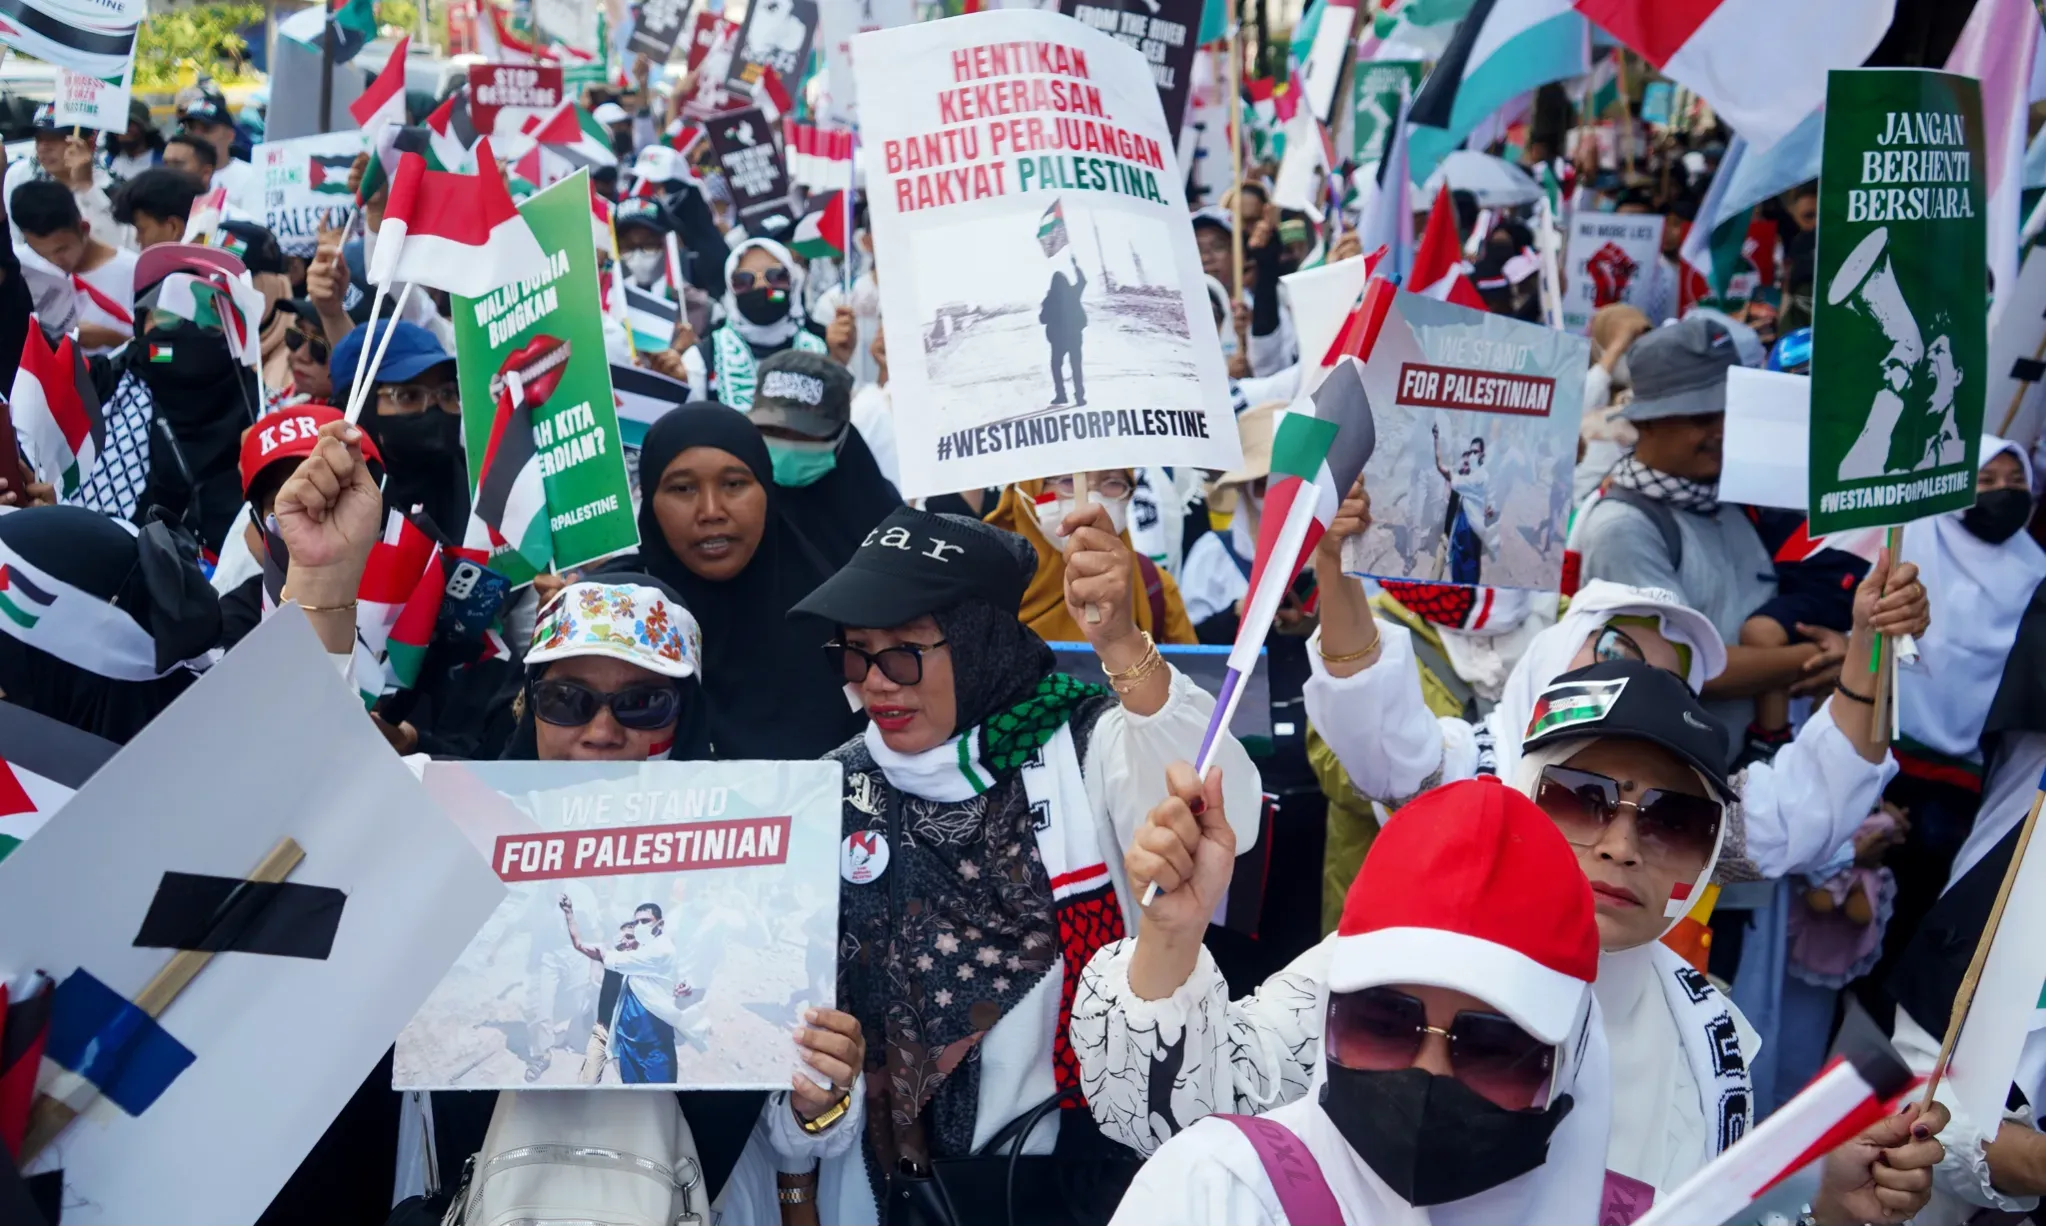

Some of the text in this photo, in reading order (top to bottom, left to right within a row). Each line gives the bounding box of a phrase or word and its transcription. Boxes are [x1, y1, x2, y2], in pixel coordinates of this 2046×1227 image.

[1121, 11, 1148, 38] THE
[1148, 18, 1187, 47] RIVER
[952, 41, 1090, 82] HENTIKAN
[938, 79, 1112, 124] KEKERASAN.
[884, 118, 1165, 174] BANTU PERJUANGAN
[1877, 112, 1964, 146] JANGAN
[895, 155, 1168, 212] RAKYAT PALESTINA.
[1861, 151, 1970, 184] BERHENTI
[1847, 188, 1974, 222] BERSUARA.
[488, 286, 558, 349] BUNGKAM
[1439, 337, 1528, 370] WE STAND
[1402, 369, 1551, 412] FOR PALESTINIAN
[533, 400, 595, 449] AH KITA
[937, 409, 1210, 461] #WESTANDFORPALESTINE
[539, 426, 606, 477] ERDIAM?
[1820, 471, 1968, 513] #WESTANDFORPALESTINE
[561, 787, 728, 827] WE STAND
[501, 825, 782, 874] FOR PALESTINIAN
